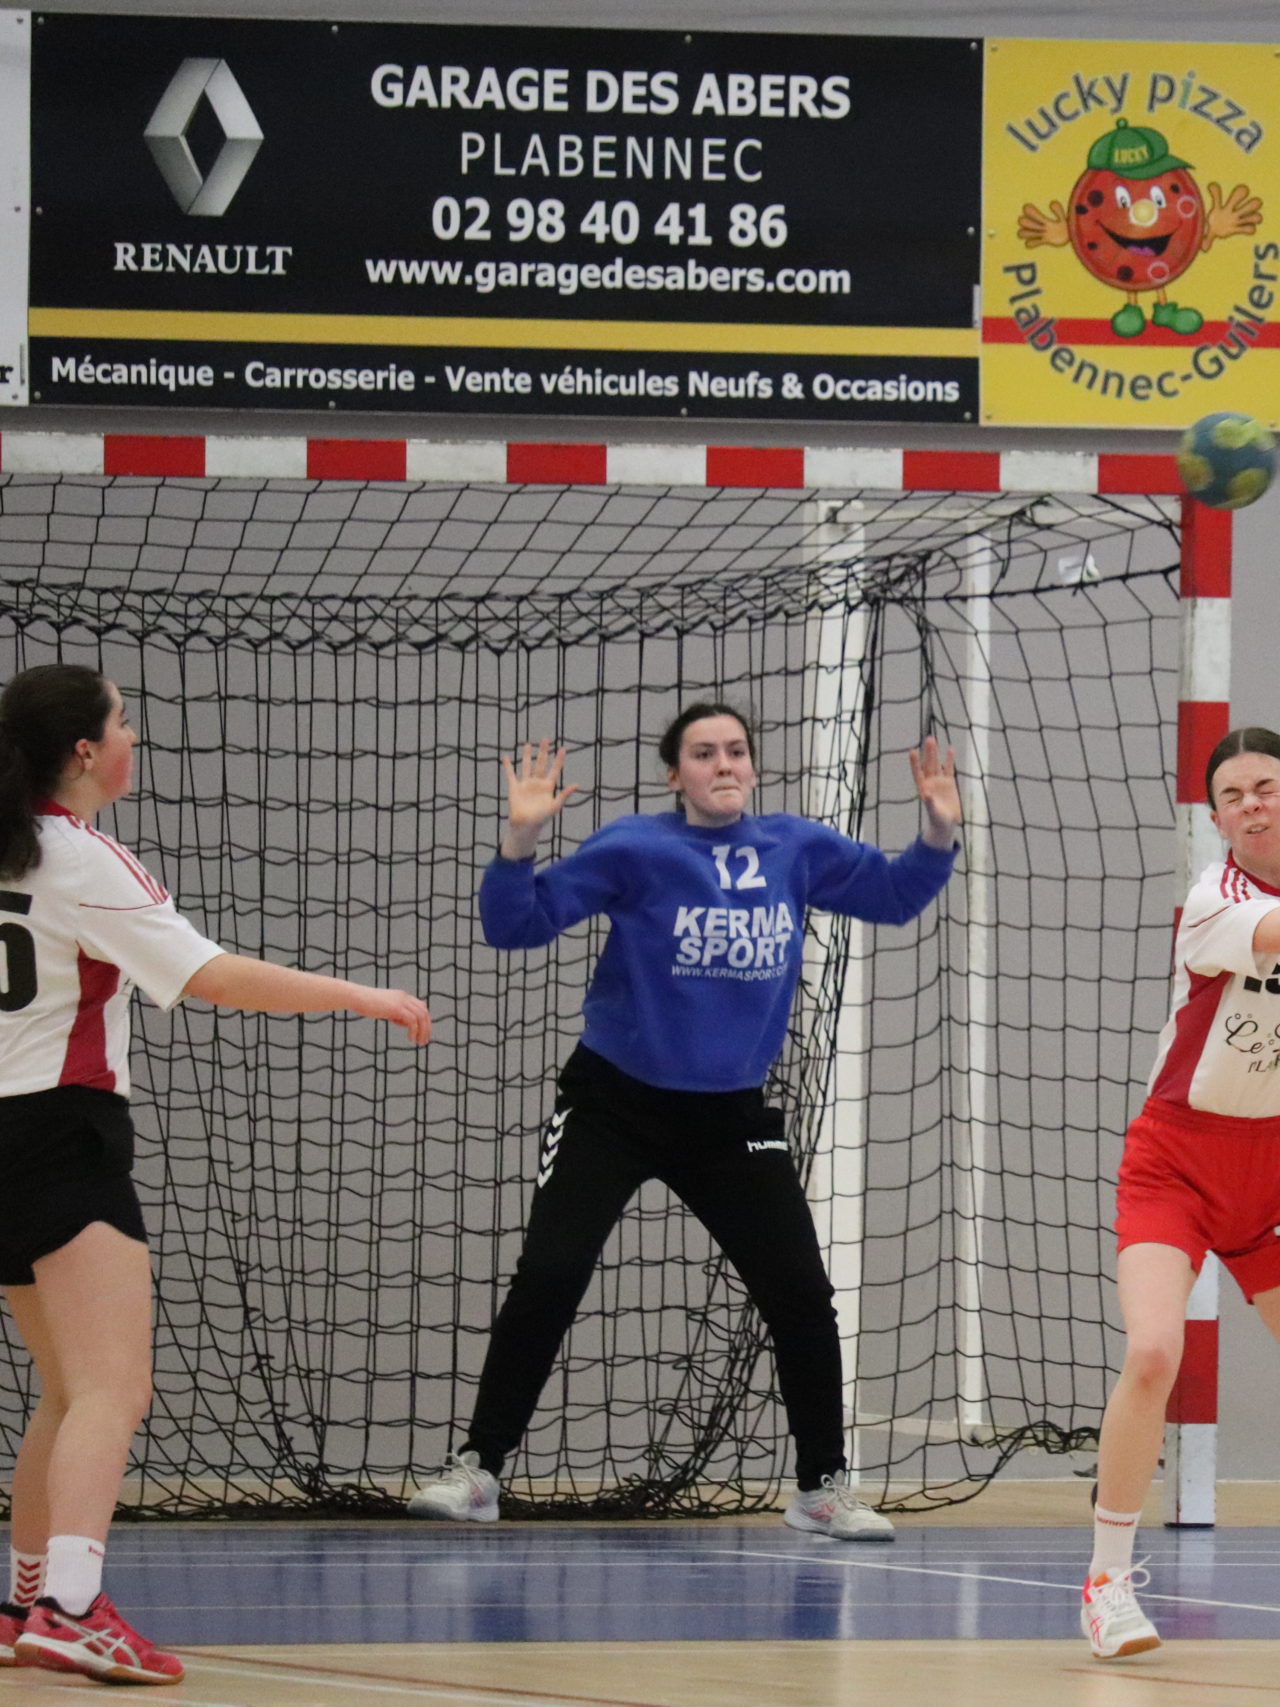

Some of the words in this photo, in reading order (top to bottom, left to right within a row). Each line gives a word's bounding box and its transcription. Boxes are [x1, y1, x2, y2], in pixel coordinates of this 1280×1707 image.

[371, 64, 569, 112] GARAGE
[586, 71, 680, 115] DES
[692, 74, 851, 119] ABERS
[1006, 72, 1129, 153] lucky
[1147, 70, 1264, 154] pizza
[461, 132, 763, 182] PLABENNEC
[1115, 145, 1149, 164] LUCKY
[433, 197, 492, 241] 02
[506, 198, 566, 242] 98
[580, 200, 640, 244] 40
[655, 203, 713, 246] 41
[728, 204, 788, 248] 86
[114, 243, 293, 275] RENAULT
[366, 256, 851, 295] www.garagedesabers.com
[1003, 241, 1280, 400] Plabennec-Guilers
[52, 355, 214, 391] Mécanique
[244, 361, 416, 392] Carrosserie
[445, 366, 533, 394] Vente
[541, 365, 680, 397] véhicules
[688, 370, 774, 399] Neufs
[782, 373, 804, 400] &
[812, 374, 960, 403] Occasions
[712, 845, 767, 890] 12
[673, 902, 794, 939] KERMA
[676, 932, 791, 969] SPORT
